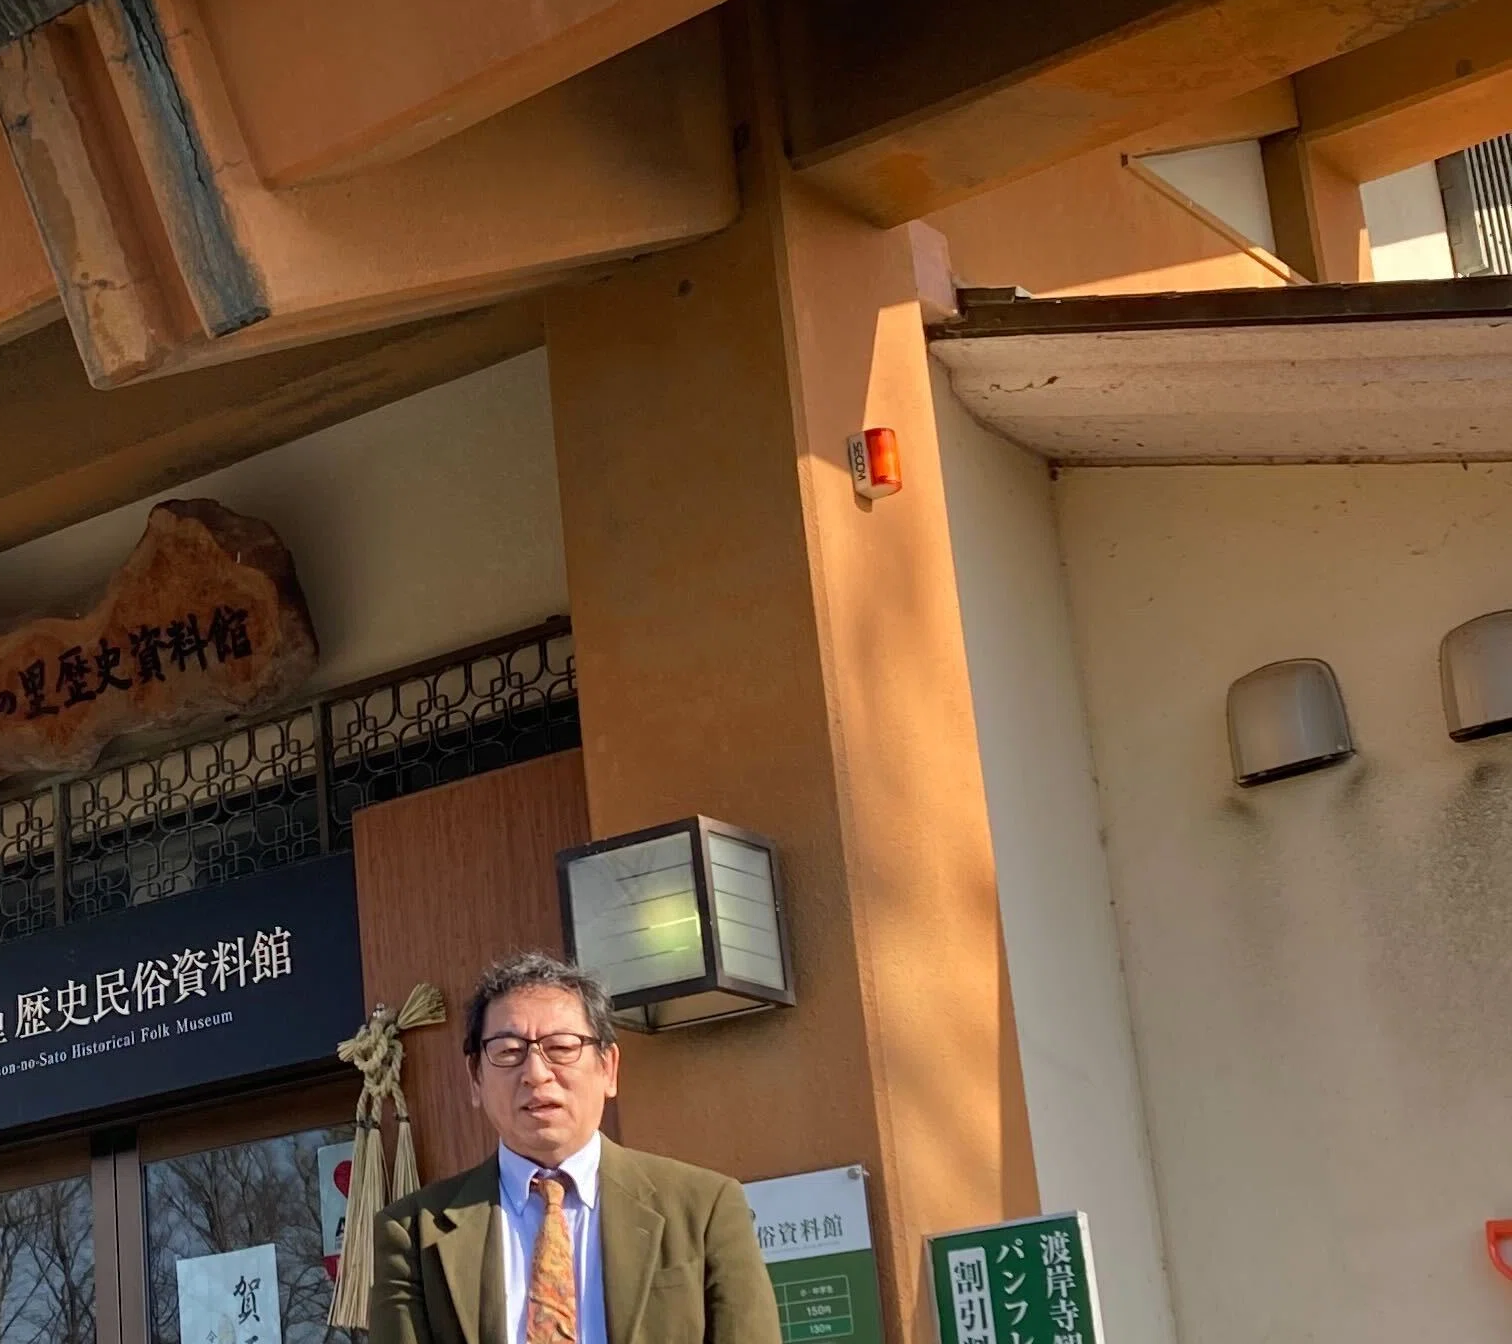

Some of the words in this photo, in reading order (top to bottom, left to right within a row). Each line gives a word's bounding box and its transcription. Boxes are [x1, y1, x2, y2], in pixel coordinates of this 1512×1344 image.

[15, 926, 292, 1039] 歴史民俗資料館
[71, 1030, 136, 1060] Historical
[140, 1022, 170, 1044] Folk
[176, 1010, 234, 1035] Museum
